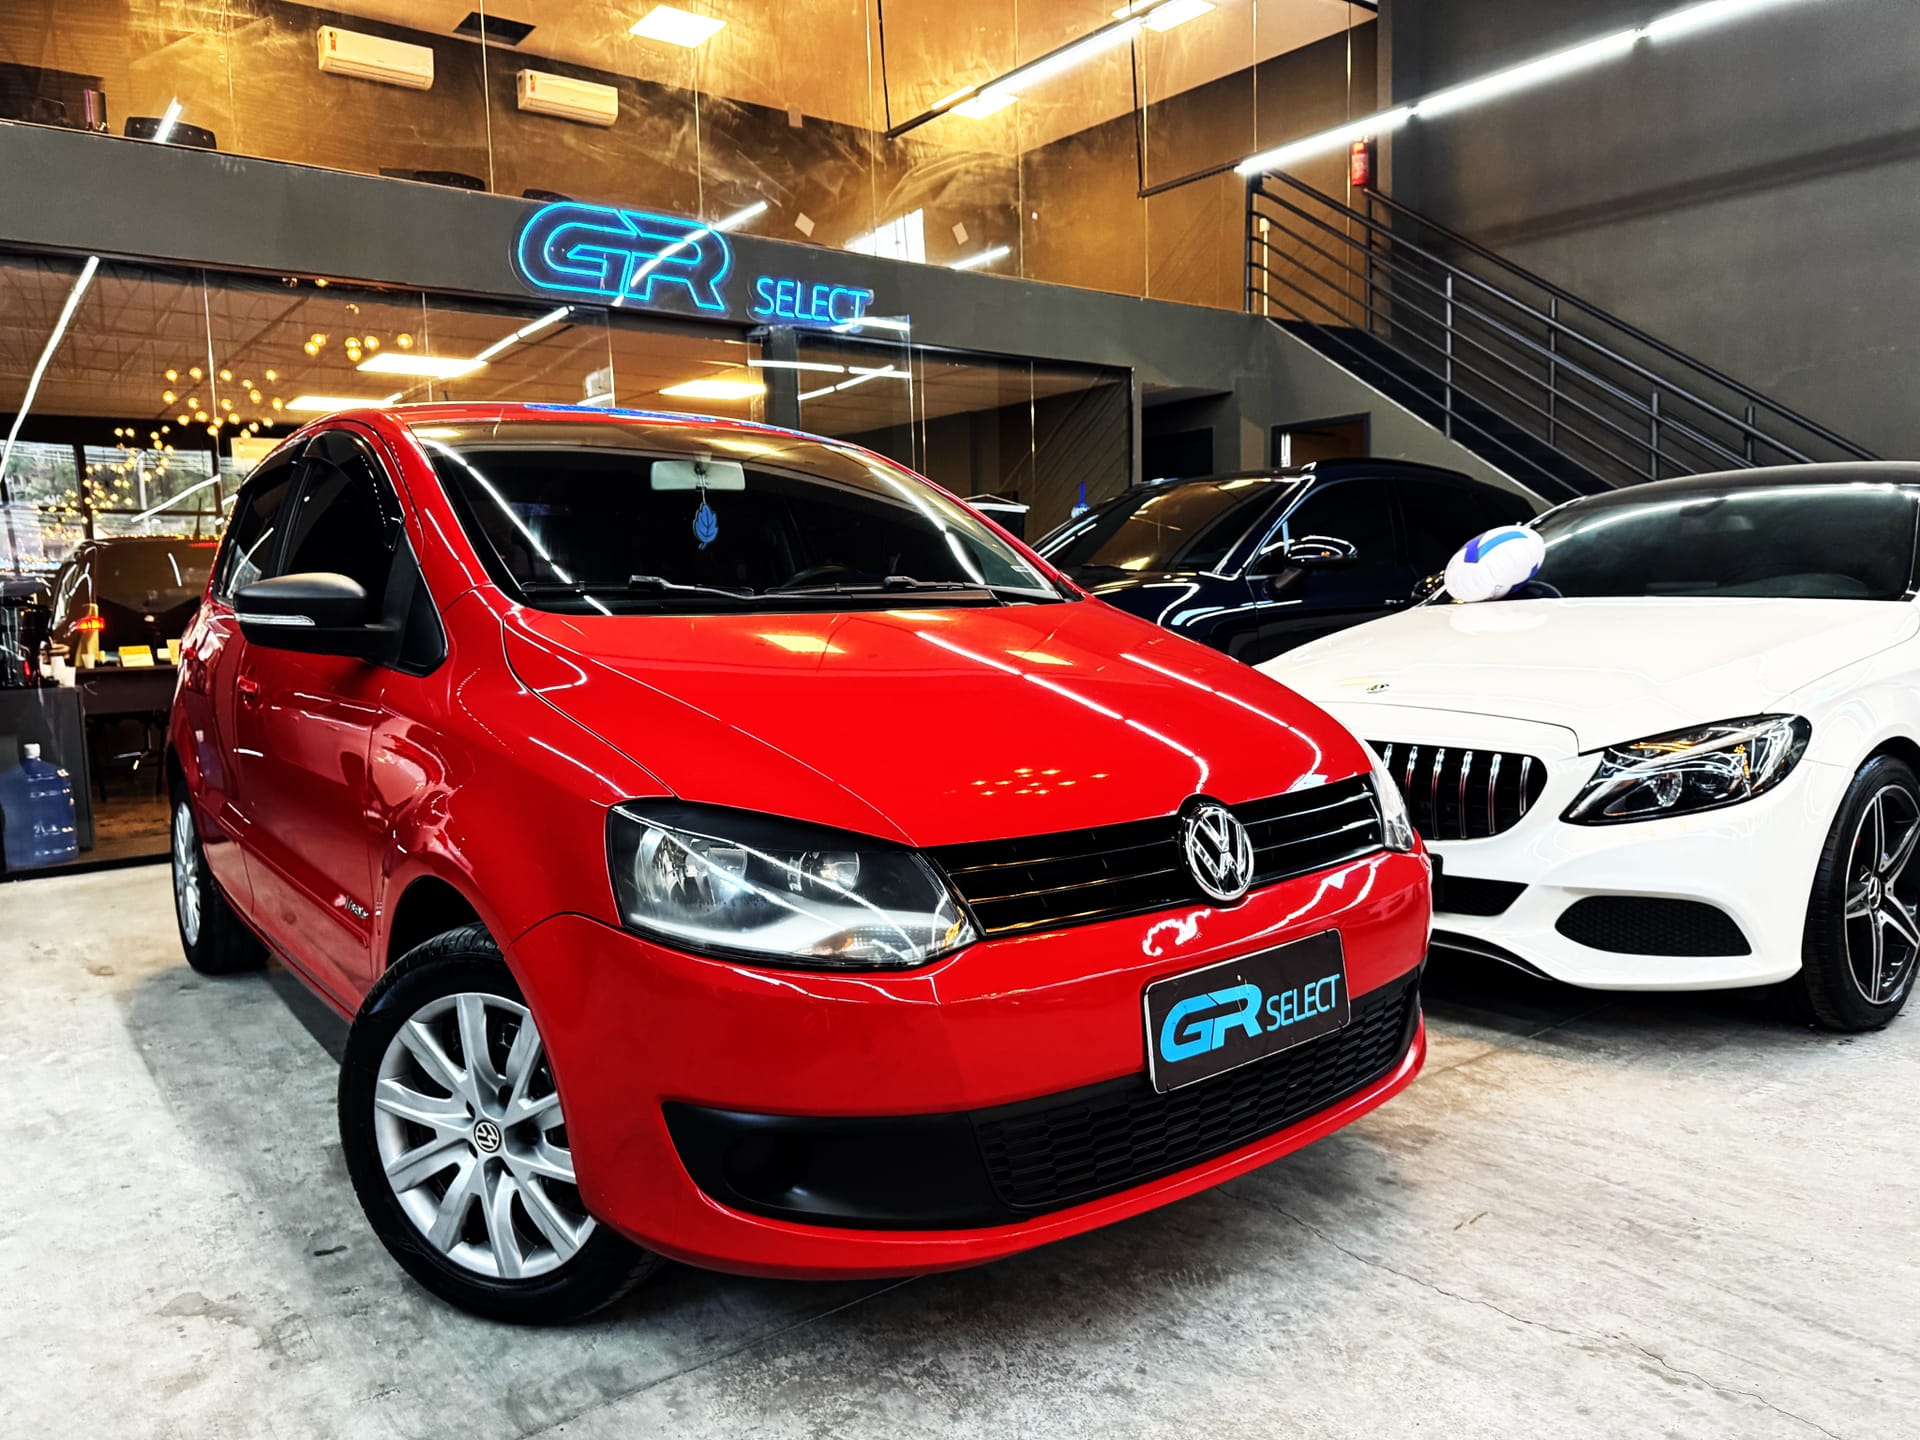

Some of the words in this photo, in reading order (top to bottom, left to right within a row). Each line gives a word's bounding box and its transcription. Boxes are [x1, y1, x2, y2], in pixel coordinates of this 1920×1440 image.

[518, 201, 730, 311] GR
[753, 277, 870, 326] SELECT
[1185, 803, 1254, 901] VW
[1160, 983, 1263, 1063] GR
[1266, 973, 1341, 1032] SELECT
